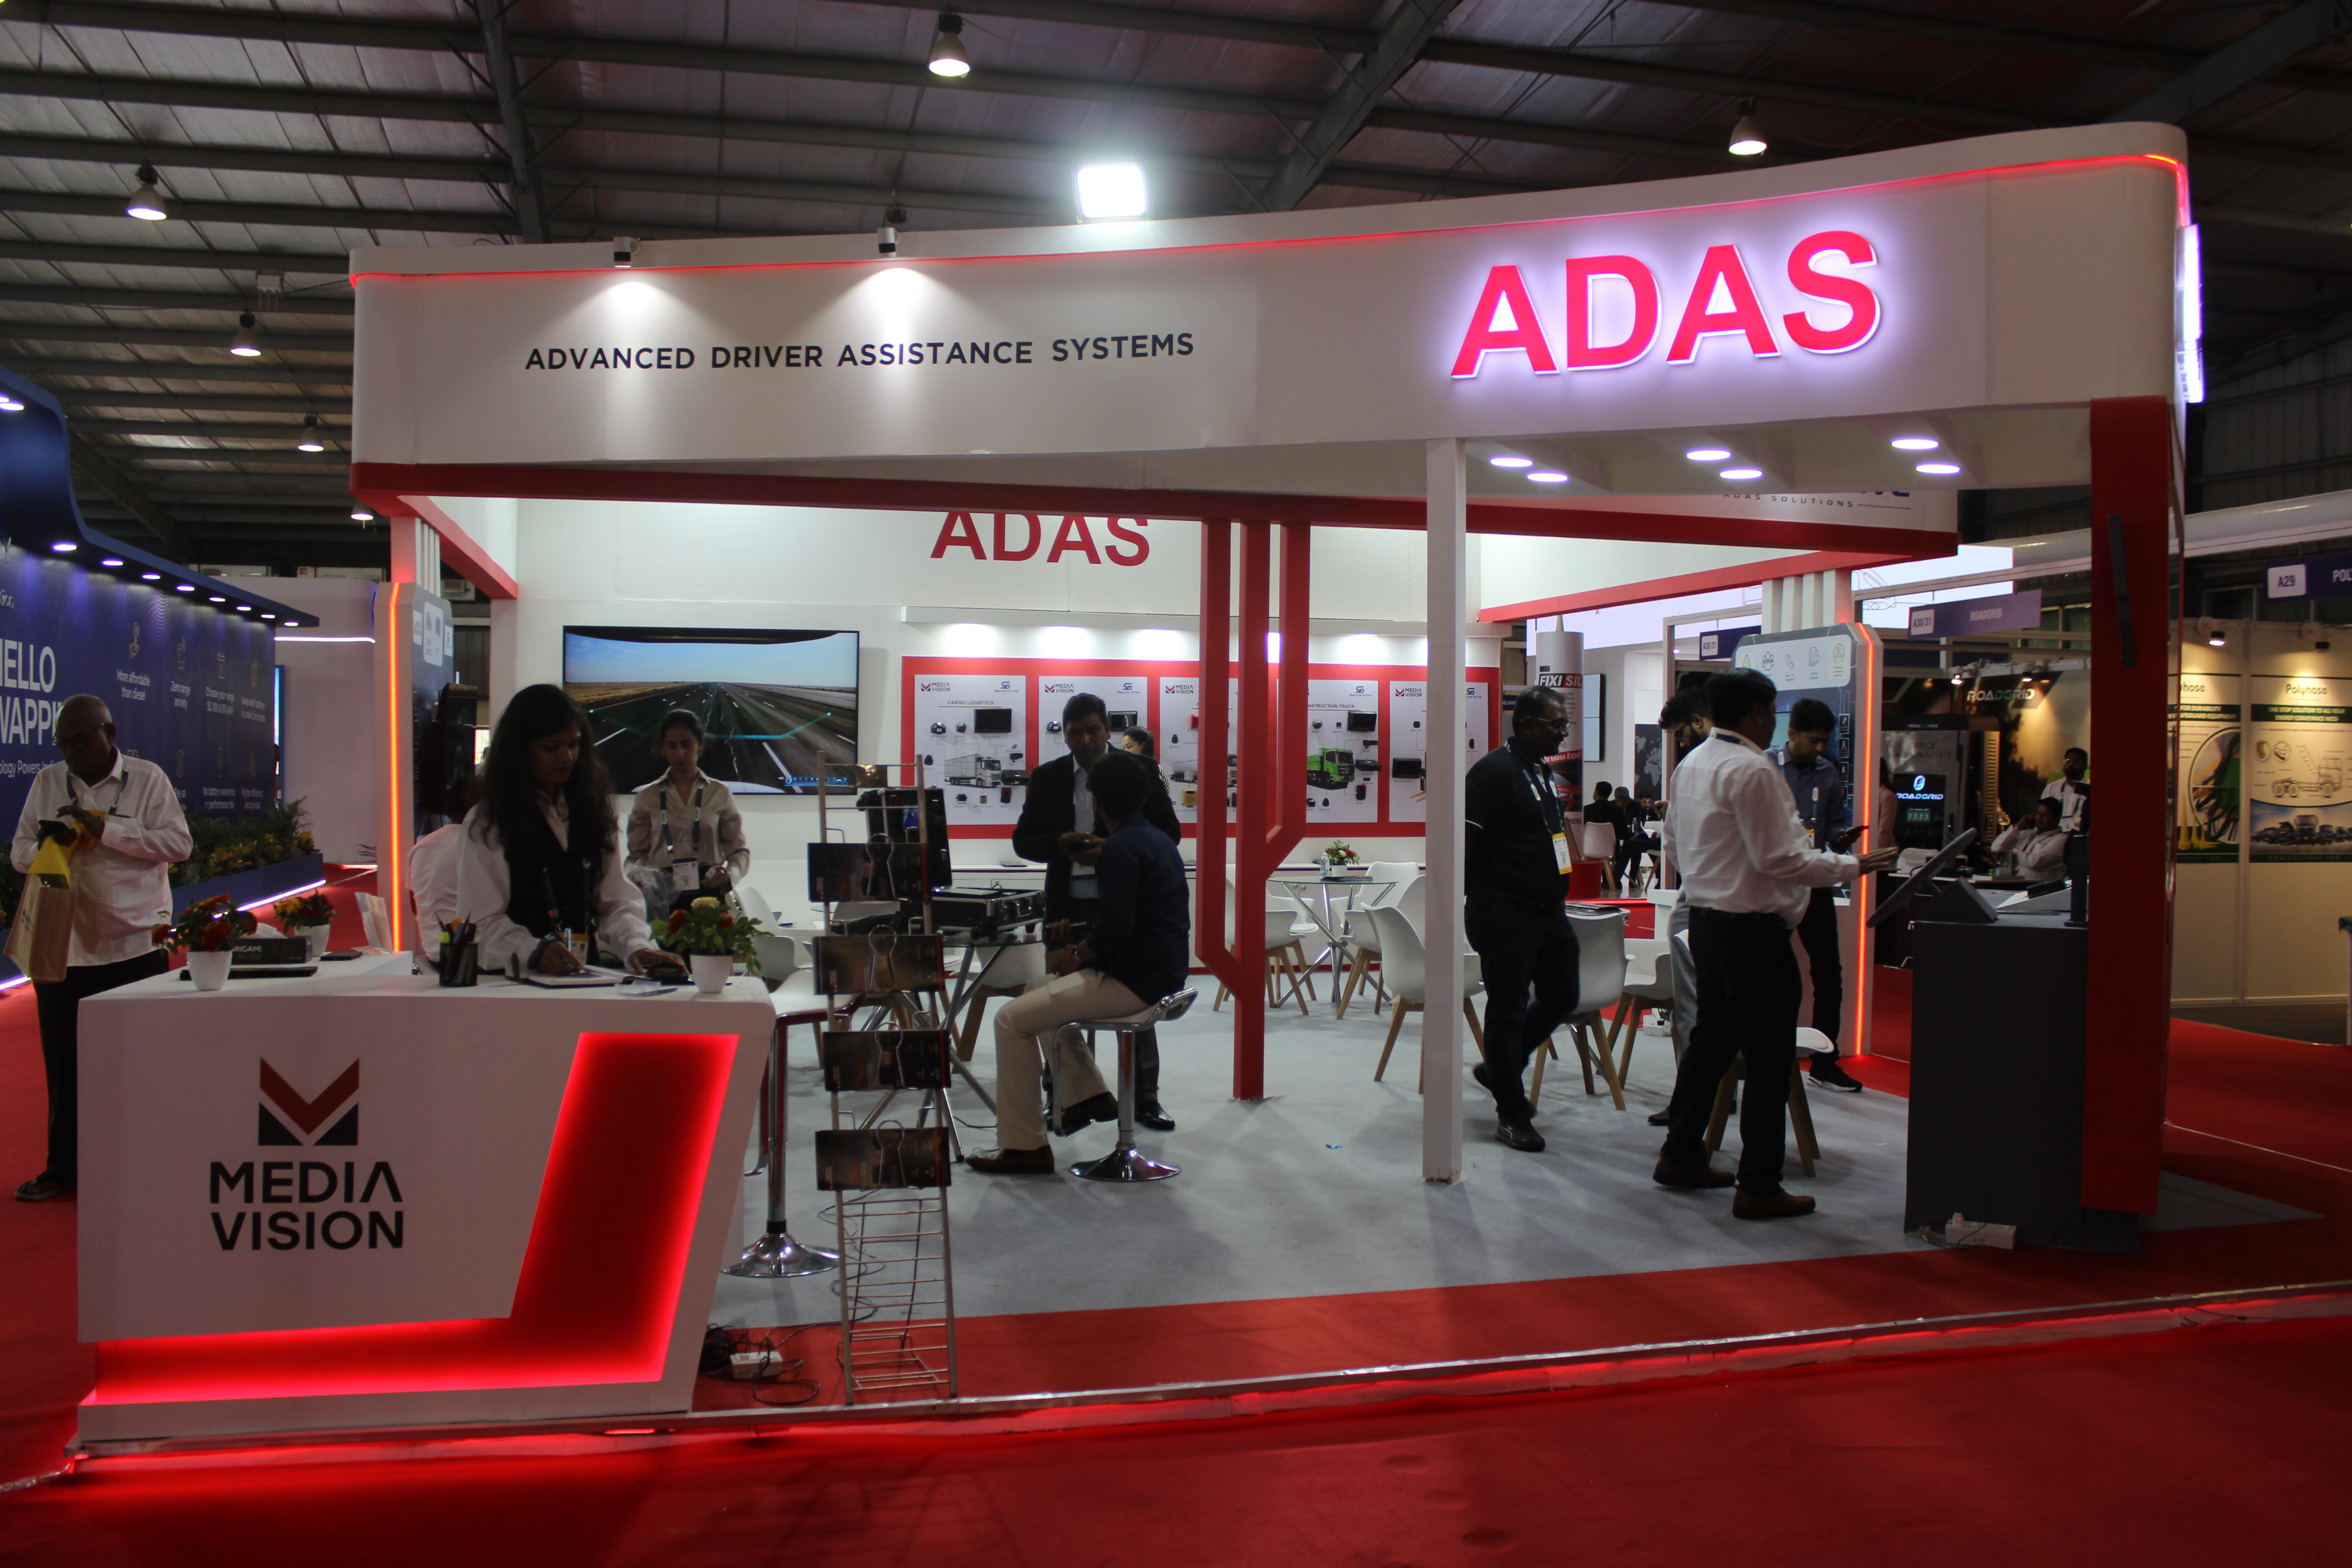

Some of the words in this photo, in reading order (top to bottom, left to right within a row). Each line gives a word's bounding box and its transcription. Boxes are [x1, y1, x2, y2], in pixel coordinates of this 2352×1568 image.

[1450, 230, 1880, 378] ADAS
[525, 347, 695, 370] ADVANCED
[711, 345, 823, 368] DRIVER
[837, 341, 1033, 367] ASSISTANCE
[1052, 332, 1194, 361] SYSTEMS
[1771, 495, 1853, 507] SOLUTIONS
[930, 511, 1149, 566] ADAS
[2278, 575, 2295, 588] A29
[2332, 568, 2352, 583] POL
[1970, 608, 2003, 621] ROADGRID
[0, 638, 56, 693] ELLO
[1539, 675, 1563, 686] FIXI
[1565, 675, 1582, 686] SIL
[2180, 683, 2205, 692] hose
[1967, 688, 2035, 701] ROADGRID
[2286, 684, 2328, 696] Polyhose
[18, 760, 40, 774] Powers
[210, 1161, 403, 1204] MEDIA
[211, 1210, 403, 1251] VISION
